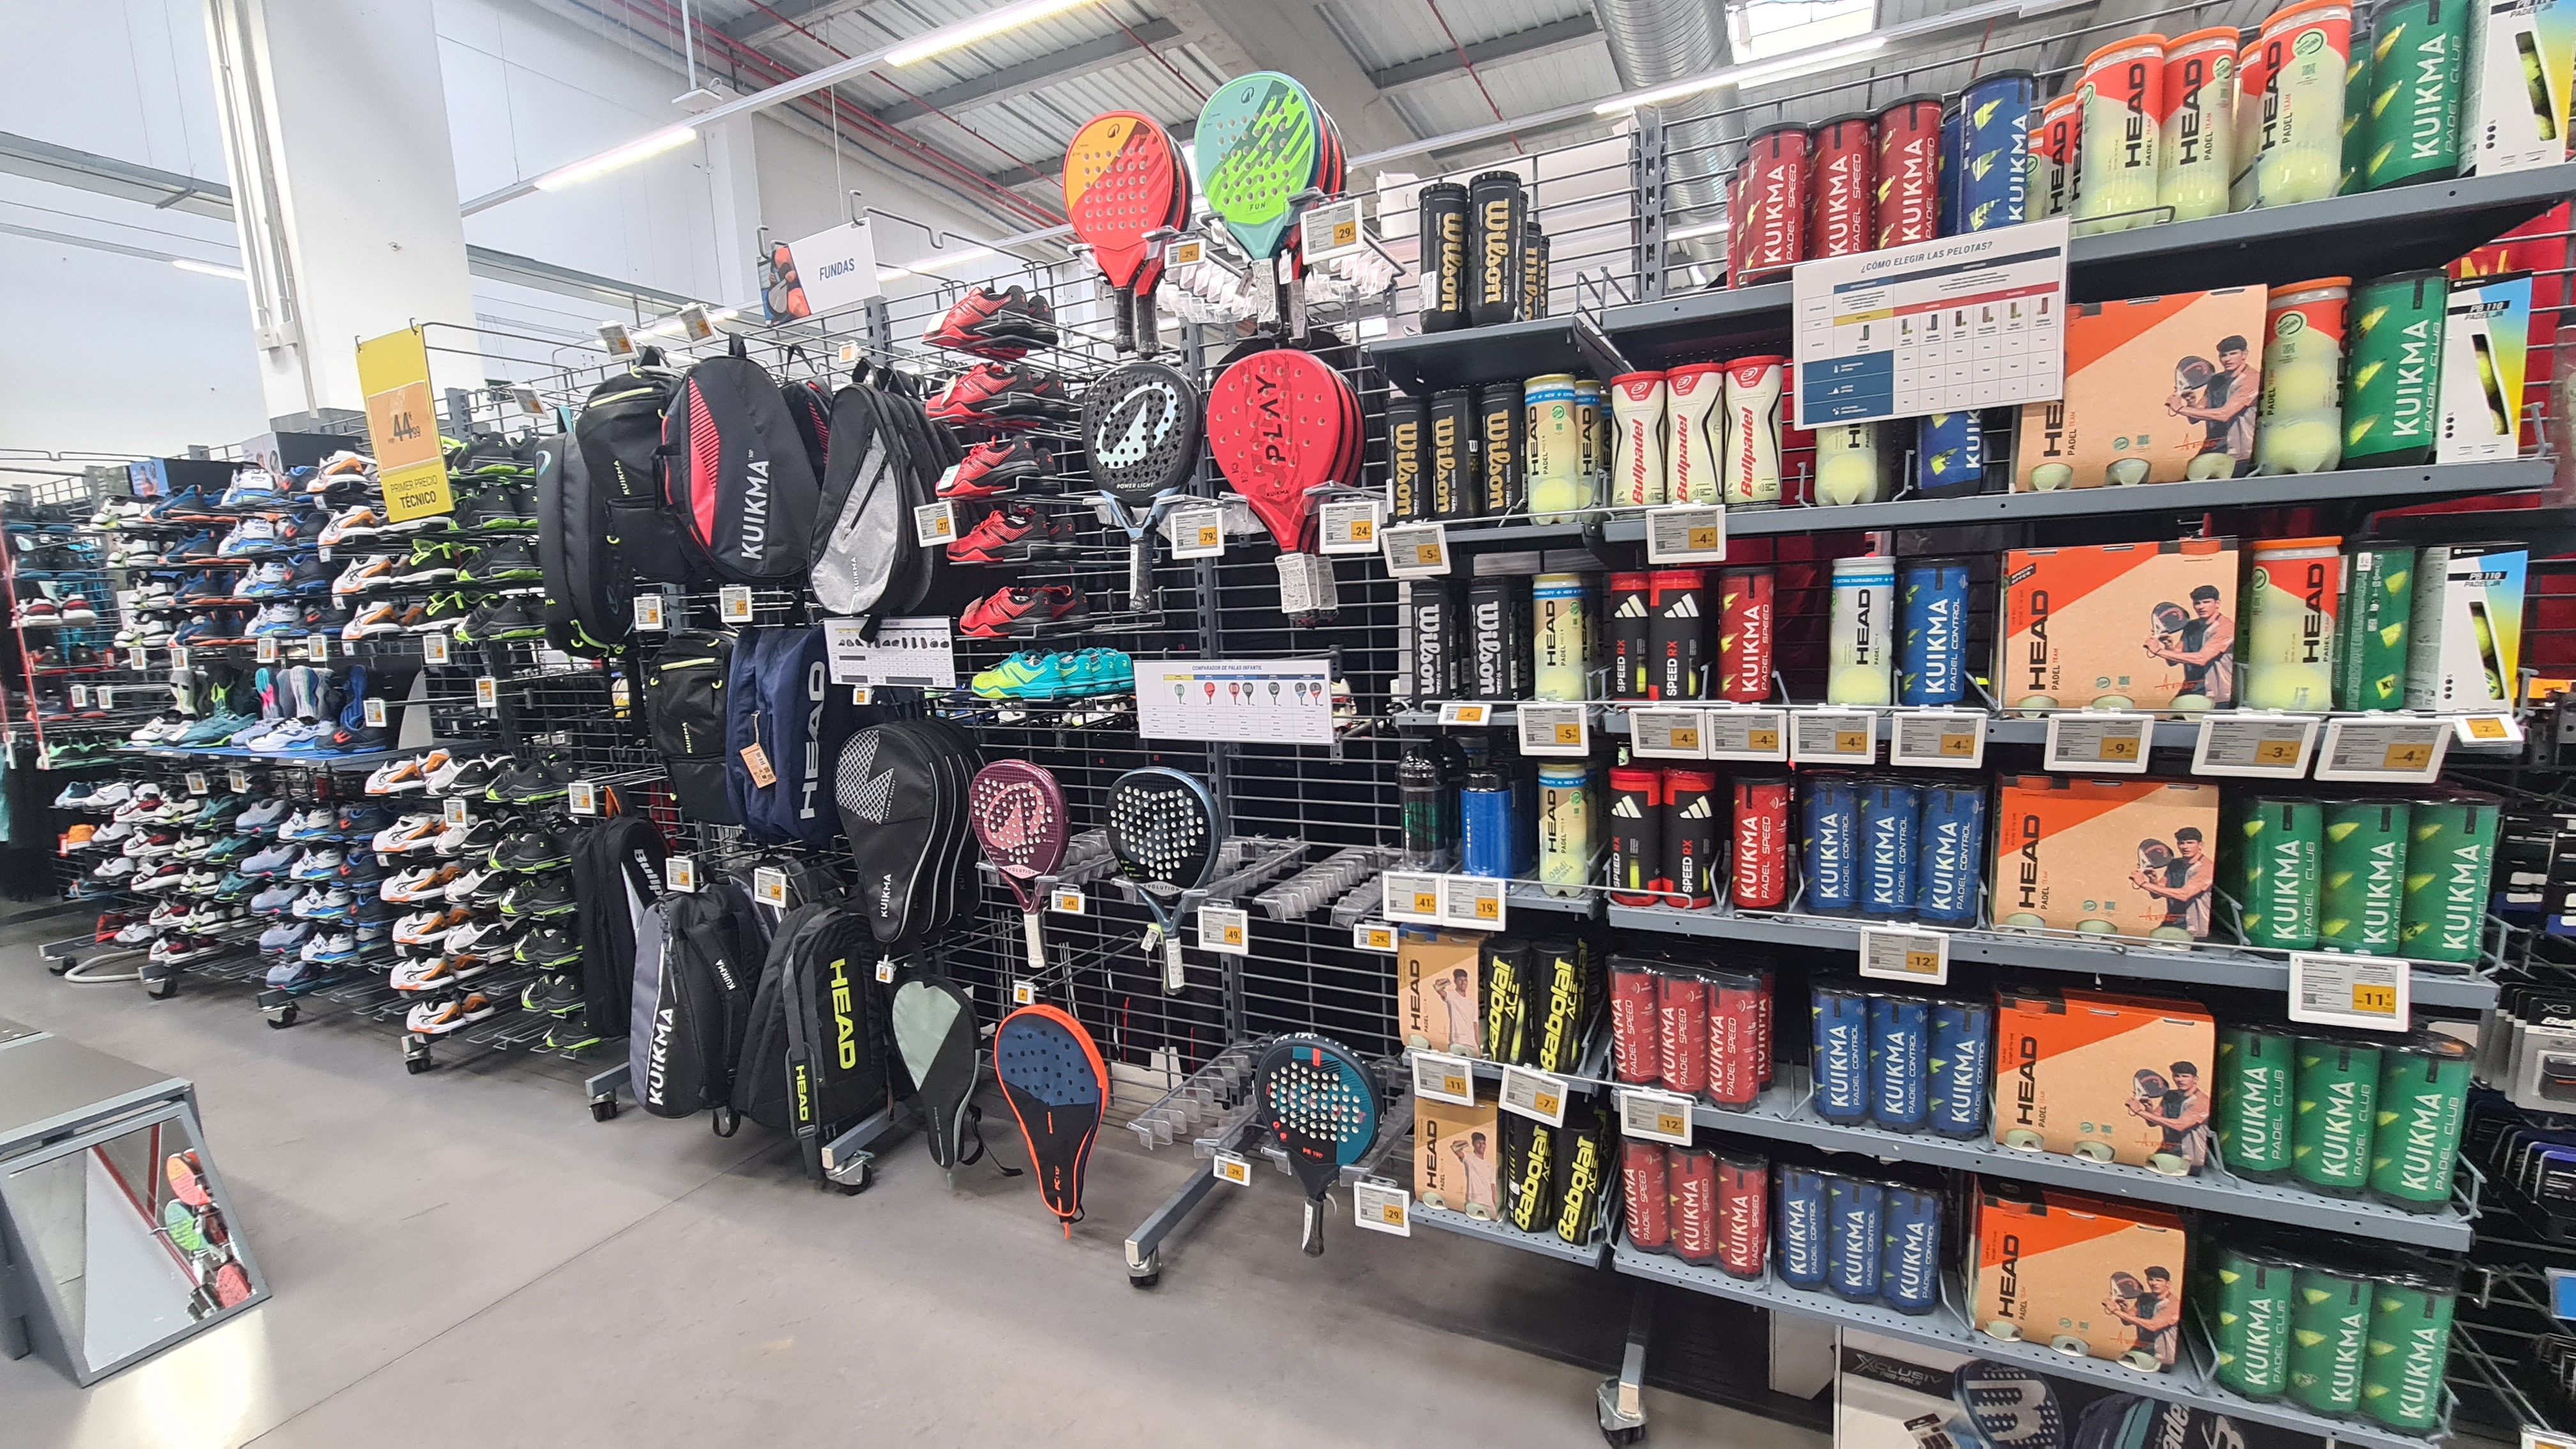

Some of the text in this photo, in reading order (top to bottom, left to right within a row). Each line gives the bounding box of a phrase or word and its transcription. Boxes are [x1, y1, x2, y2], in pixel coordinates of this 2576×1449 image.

[2125, 63, 2145, 168] HEAD
[2180, 59, 2202, 165] HEAD
[2261, 41, 2281, 151] HEAD
[2411, 33, 2447, 160] KUIKMA
[1829, 156, 1848, 256] KUIKMA
[1853, 154, 1861, 199] SPEED
[1901, 139, 1923, 241] KUIKMA
[1925, 137, 1935, 240] PADEL SPEED
[2009, 114, 2028, 221] KUIKMA
[2050, 121, 2066, 215] HEAD
[1250, 202, 1266, 211] FUN
[1338, 228, 1351, 239] 29
[1764, 165, 1785, 263] KUIKMA
[1786, 164, 1797, 261] PADEL SPEED
[820, 258, 855, 280] FUNDAS
[1442, 213, 1463, 312] Wilson
[1485, 198, 1510, 303] Wilson
[1861, 241, 1993, 273] ¿CÓMO ELEGIR LAS PELOTAS?
[2487, 301, 2503, 310] 110
[2393, 319, 2429, 436] KUIKMA
[1255, 374, 1285, 464] PLAY
[1529, 406, 1538, 475] HEAD
[1583, 408, 1591, 475] HEAD
[1740, 407, 1756, 498] Bullpadel
[1966, 410, 1981, 468] KUIK
[2044, 404, 2063, 457] HE
[2067, 429, 2076, 456] PADEL
[390, 475, 438, 493] PRIMER PRECIO
[613, 460, 629, 495] KUIKMA
[1395, 421, 1418, 517] Wilson
[1435, 416, 1456, 513] Wilson
[1487, 410, 1511, 509] Wilson
[1632, 419, 1646, 505] Bullpadel
[1677, 414, 1690, 502] Bullpadel
[399, 490, 436, 509] TÉCNICO
[741, 461, 769, 560] KUIKMA
[1204, 532, 1213, 540] 79
[1356, 527, 1367, 535] 24
[1700, 534, 1706, 543] 4
[1419, 604, 1440, 695] Wilson
[1477, 601, 1501, 695] Wilson
[1546, 601, 1556, 666] HEAD
[1742, 606, 1759, 691] KUIKMA
[1857, 588, 1870, 665] HEAD
[1926, 599, 1948, 693] KUIKMA
[2029, 590, 2048, 691] HEAD
[2303, 563, 2324, 663] HEAD
[1617, 640, 1626, 692] SPEED RX
[1667, 641, 1678, 696] SPEED RX
[681, 723, 692, 753] KUIKMA
[801, 661, 825, 820] HEAD
[1565, 730, 1571, 739] 5
[1682, 734, 1687, 742] 4
[1761, 736, 1767, 744] 4
[1848, 738, 1855, 746] 4
[1954, 741, 1960, 749] 4
[2116, 744, 2124, 753] 9
[2273, 747, 2283, 757] 3
[2403, 750, 2414, 762] 4
[1548, 790, 1556, 853] HEAD
[1613, 836, 1620, 852] RX
[1741, 816, 1758, 898] KUIKMA
[1821, 813, 1839, 898] KUIKMA
[1874, 816, 1895, 903] KUIKMA
[880, 874, 892, 918] KUIKMA
[1683, 839, 1692, 893] SPEED RX
[1931, 822, 1958, 910] KUIKMA
[2018, 815, 2041, 909] HEAD
[2273, 839, 2300, 939] KUIKMA
[2303, 841, 2315, 938] PADEL CLUB
[2363, 841, 2396, 944] KUIKMA
[2442, 844, 2481, 949] KUIKMA
[1420, 898, 1430, 907] 41
[1482, 903, 1492, 913] 19
[716, 959, 736, 990] KUIKMA
[1411, 959, 1421, 1031] HEAD
[1915, 957, 1929, 966] 12
[2363, 992, 2383, 1006] 11
[830, 958, 857, 1070] HEAD
[1504, 983, 1520, 1020] ACE
[1540, 957, 1573, 1072] Babolat
[1565, 982, 1578, 1020] ACE
[1612, 999, 1627, 1073] KUIKMA
[1625, 1000, 1635, 1036] SPEED
[1678, 1008, 1687, 1045] SPEED
[1728, 1017, 1737, 1054] SPEED
[648, 1008, 673, 1105] KUIKMA
[1662, 1007, 1676, 1084] KUIKMA
[1710, 1015, 1724, 1093] KUIKMA
[1829, 1025, 1849, 1108] KUIKMA
[1885, 1032, 1905, 1115] KUIKMA
[1951, 1040, 1975, 1124] KUIKMA
[2017, 1036, 2037, 1125] HEAD
[795, 1065, 808, 1121] HEAD
[1544, 1100, 1550, 1108] 7
[1665, 1120, 1678, 1129] 12
[2241, 1067, 2267, 1161] KUIKMA
[2271, 1070, 2284, 1160] PADEL CLUB
[2322, 1082, 2355, 1176] KUIKMA
[2354, 1084, 2371, 1176] PADEL CLUB
[1427, 1120, 1437, 1189] HEAD
[1514, 1124, 1549, 1231] Babolat
[1587, 1159, 1598, 1194] ACE
[2401, 1094, 2442, 1191] KUIKMA
[1388, 1210, 1399, 1219] 29
[1558, 1136, 1595, 1242] Babolat
[1626, 1169, 1640, 1238] KUIKMA
[1684, 1180, 1699, 1252] KUIKMA
[1731, 1195, 1748, 1268] KUIKMA
[1790, 1200, 1807, 1275] KUIKMA
[1846, 1211, 1864, 1287] KUIKMA
[1899, 1223, 1924, 1300] KUIKMA
[1998, 1234, 2020, 1317] HEAD
[2245, 1298, 2271, 1385] KUIKMA
[2332, 1313, 2362, 1403] KUIKMA
[2399, 1329, 2438, 1419] KUIKMA
